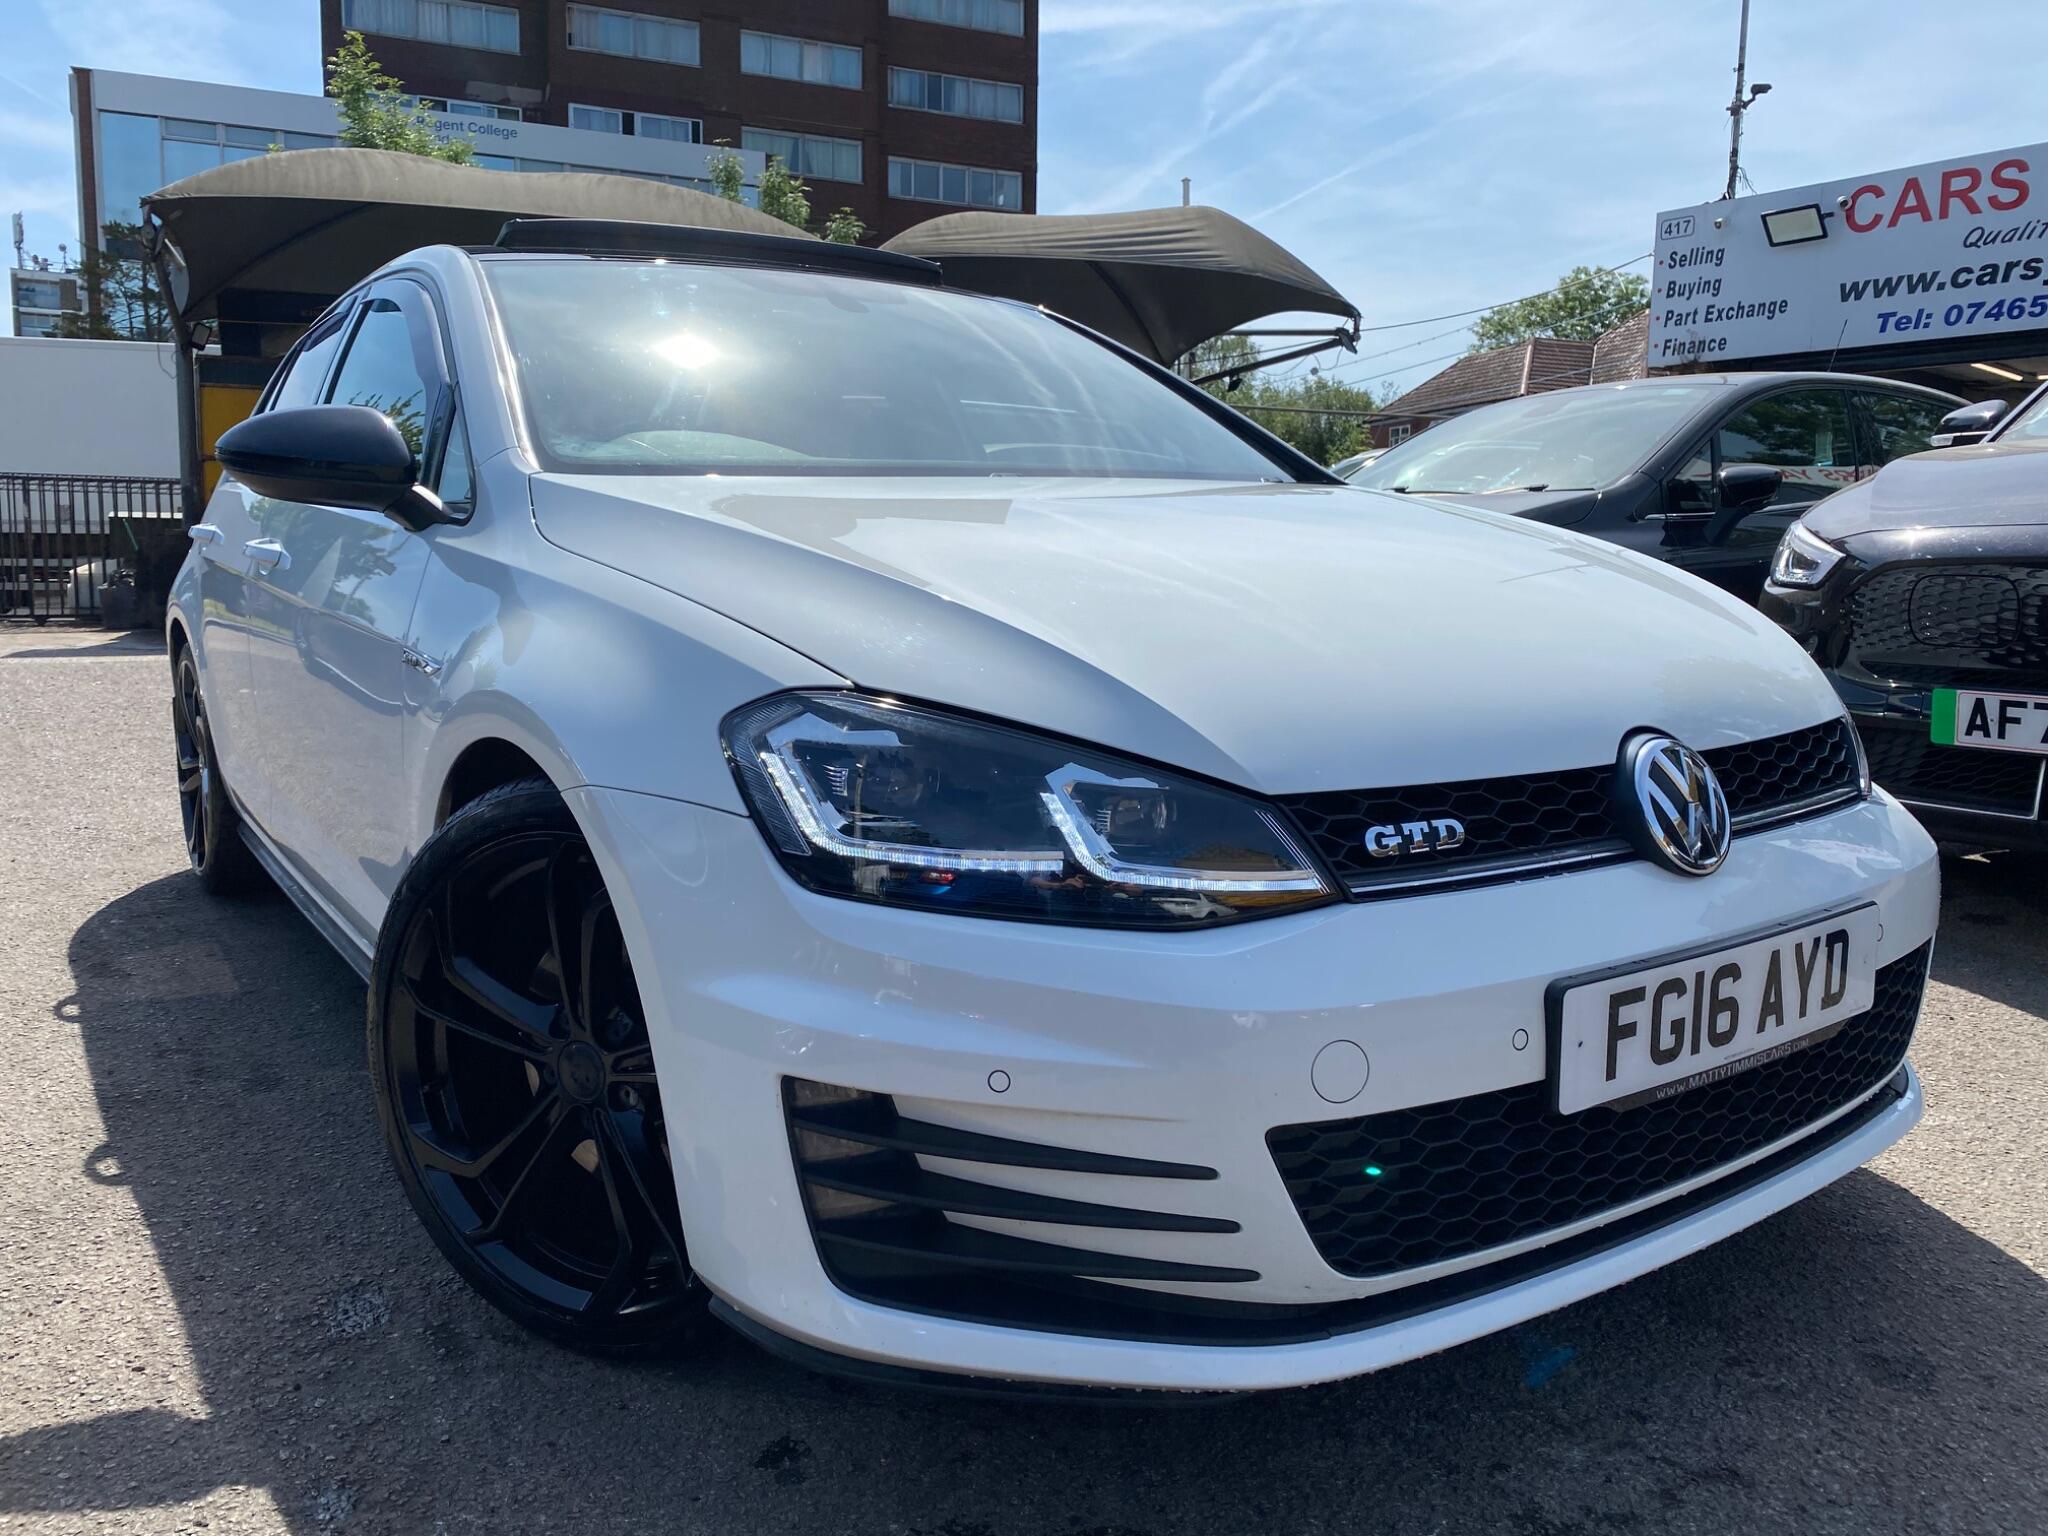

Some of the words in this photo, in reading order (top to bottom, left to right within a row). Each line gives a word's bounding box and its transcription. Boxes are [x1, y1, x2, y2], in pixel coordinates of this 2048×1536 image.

[467, 122, 518, 140] College
[1845, 158, 2030, 233] CARS
[1664, 219, 1691, 237] 417
[1668, 246, 1725, 269] Selling
[1665, 276, 1722, 300] Buying
[1840, 257, 2048, 303] www.cars
[1663, 306, 1699, 328] Part
[1703, 299, 1788, 323] Exchange
[1877, 307, 1934, 334] Tel:
[1943, 294, 2048, 327] 07465
[1661, 337, 1727, 357] Finance
[1364, 818, 1466, 858] GTD
[1605, 962, 1742, 1082] FG16
[1756, 928, 1850, 1034] AYD
